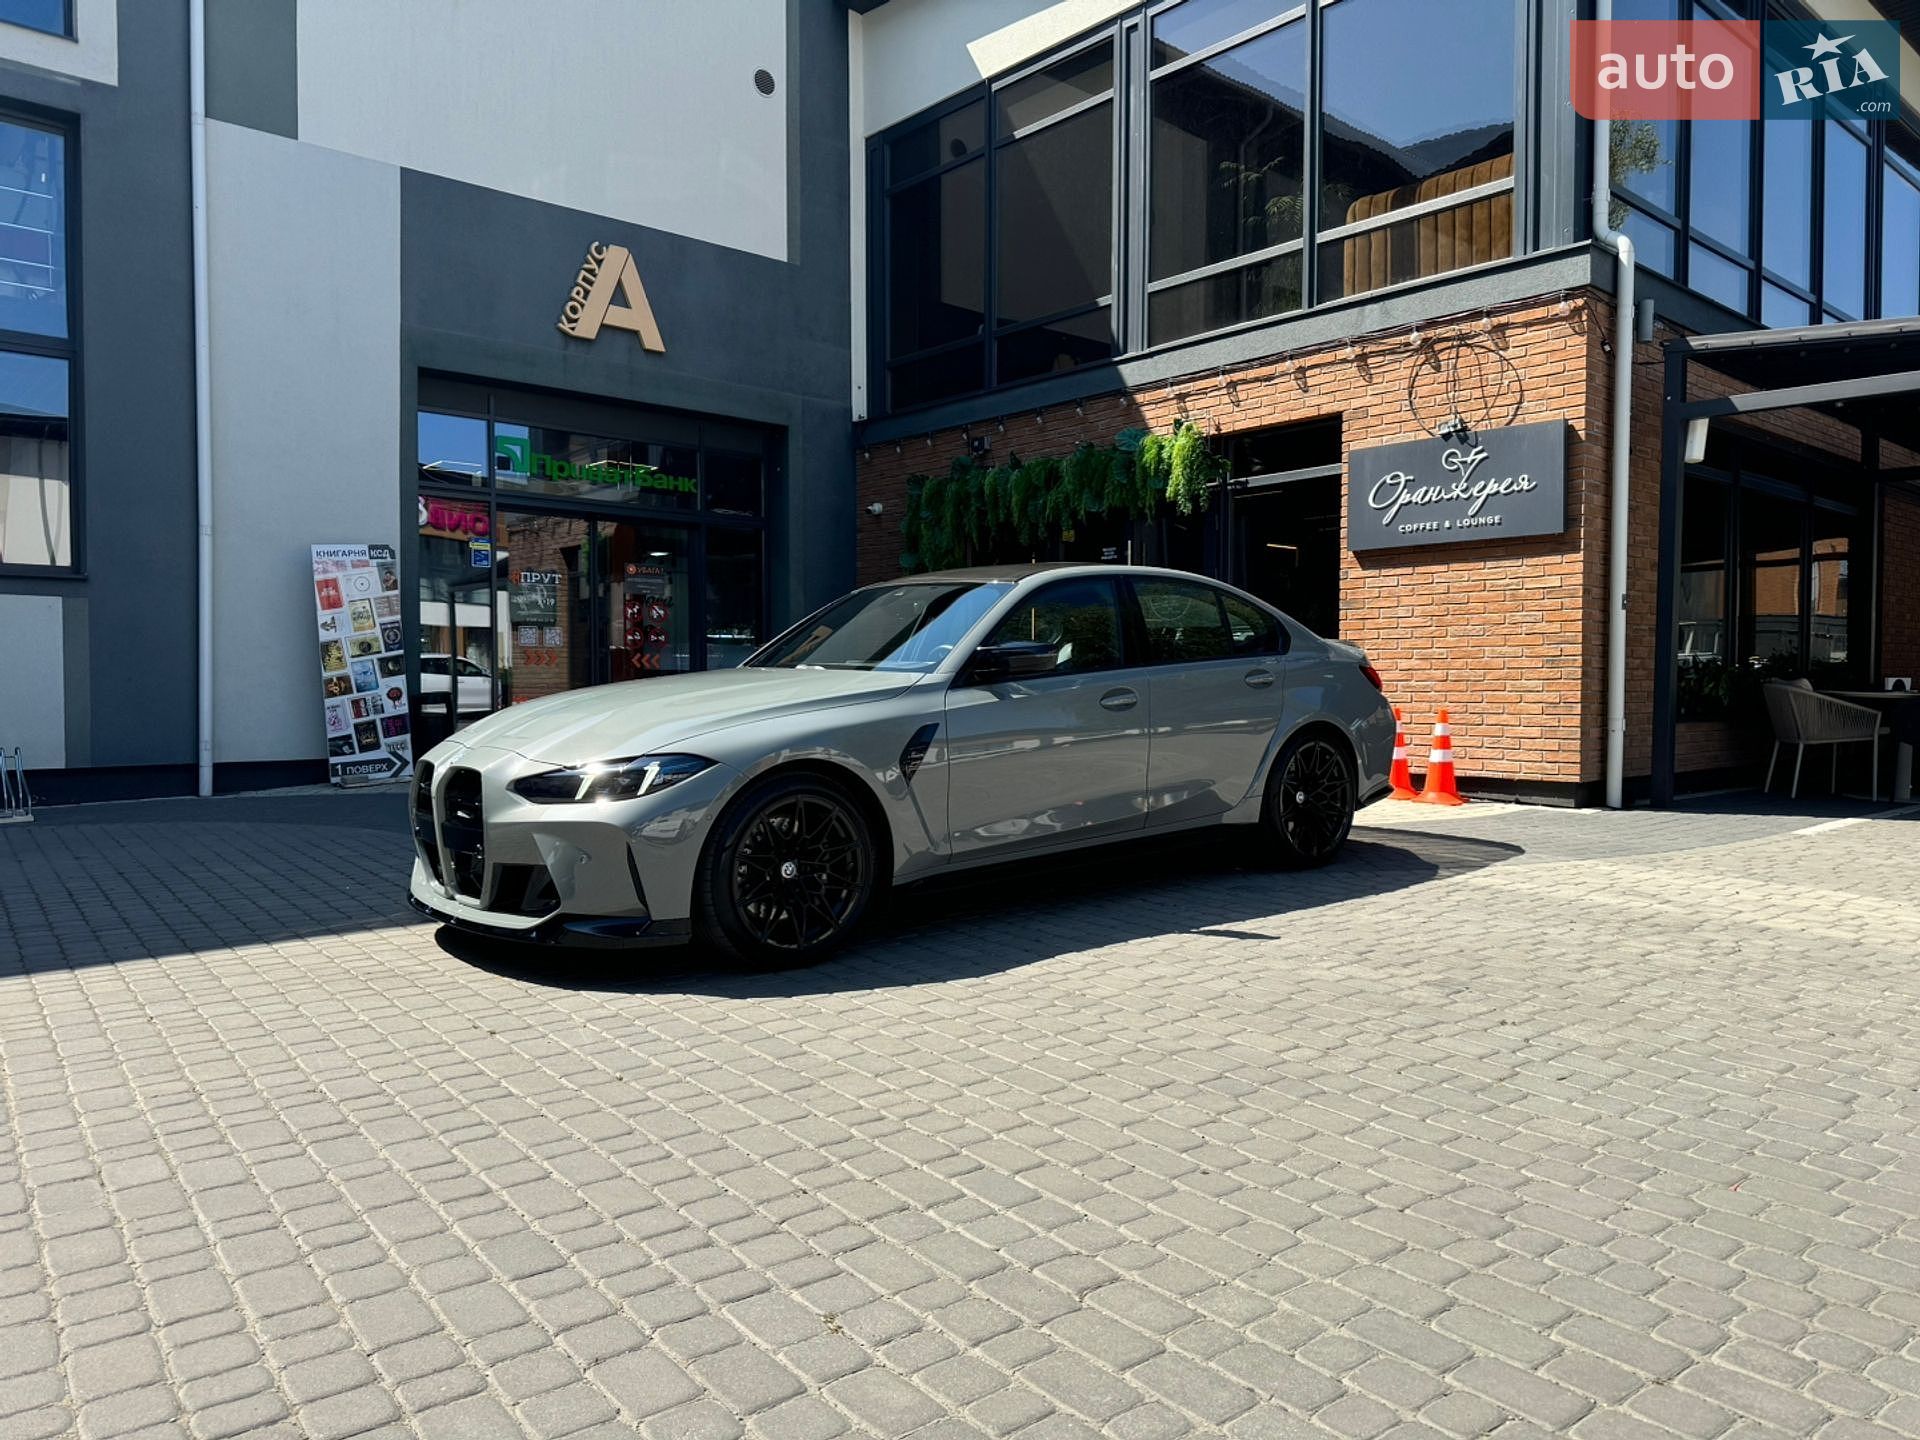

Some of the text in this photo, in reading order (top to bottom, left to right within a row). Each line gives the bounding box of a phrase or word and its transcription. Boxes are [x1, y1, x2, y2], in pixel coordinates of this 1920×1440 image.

[556, 241, 607, 337] КОРПУС
[573, 244, 667, 352] А
[529, 453, 698, 493] ПриватБанк
[1368, 446, 1538, 526] Оранжерея
[1398, 514, 1503, 533] COFFEE & LOUNGE
[315, 548, 368, 558] КНИГАРНЯ
[519, 571, 563, 585] ПРУТ
[334, 762, 390, 776] 1 ПОВЕРХ
